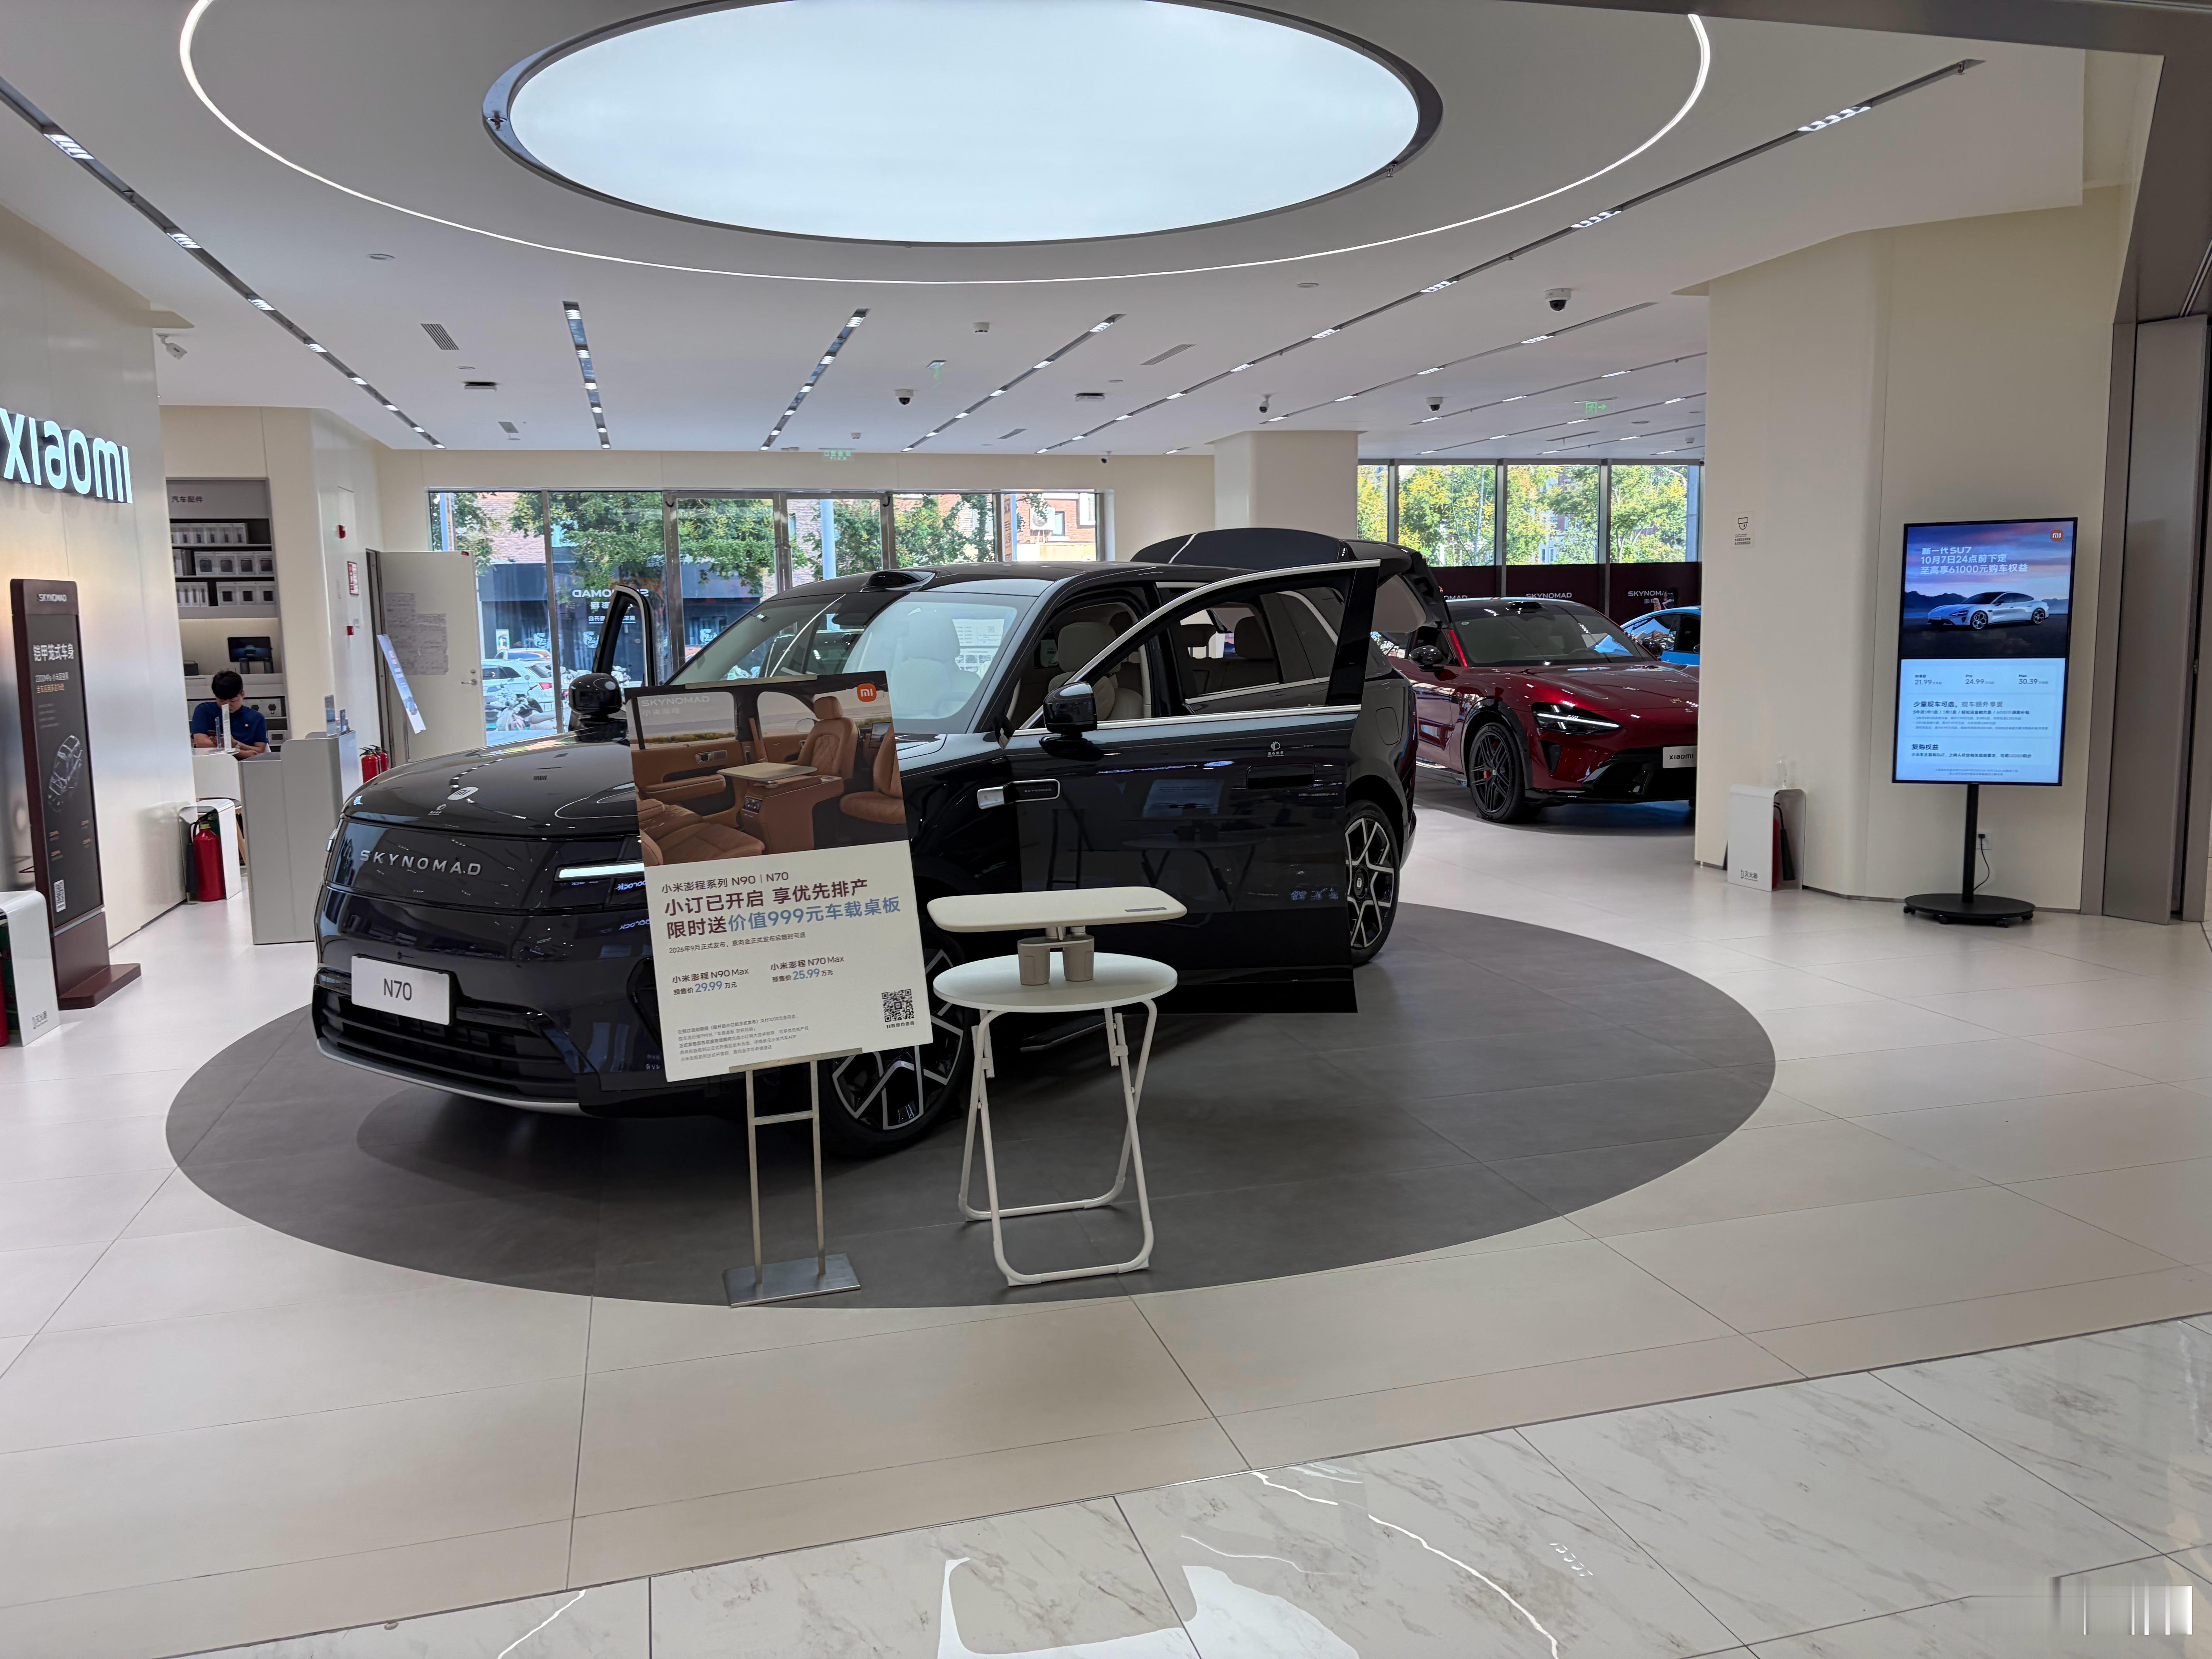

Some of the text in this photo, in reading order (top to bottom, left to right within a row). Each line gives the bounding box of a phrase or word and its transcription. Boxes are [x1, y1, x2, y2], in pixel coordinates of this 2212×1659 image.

[1921, 554, 2007, 564] 10月7日24点前下定
[1920, 563, 2028, 575] 至高享61000元购车权益
[641, 696, 710, 707] SKYNOMAD
[360, 850, 481, 876] SKYNOMAD
[661, 878, 728, 893] 小米澎程系列
[732, 875, 756, 886] N90
[766, 872, 789, 882] N70
[665, 878, 868, 916] 小订已开启 享优先排产
[667, 896, 901, 939] 限时送价值999元车载桌板
[771, 955, 845, 971] 小米澎程 N70 Max
[672, 968, 749, 984] 小米澎程 N90 Max
[772, 975, 792, 983] 预售价
[792, 968, 820, 981] 25.99
[383, 978, 412, 1001] N70
[673, 987, 694, 995] 预售价
[695, 981, 723, 993] 29.99
